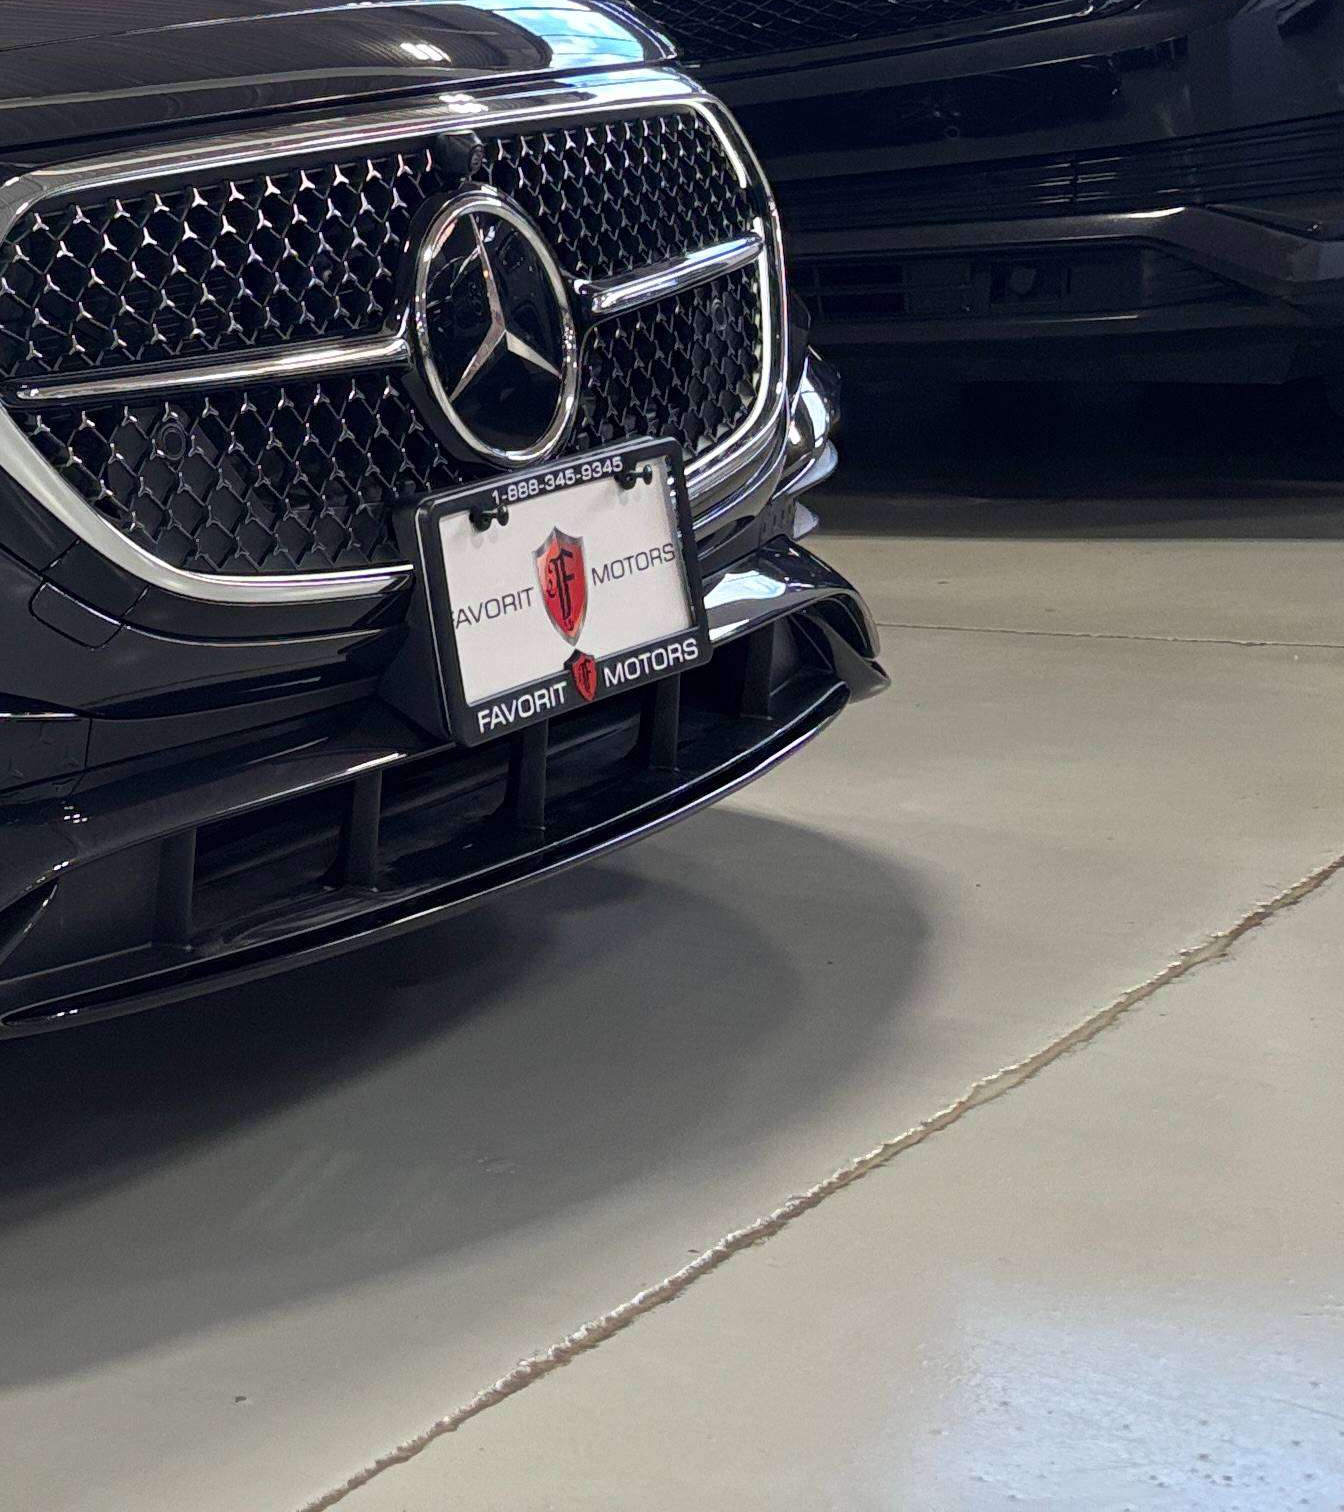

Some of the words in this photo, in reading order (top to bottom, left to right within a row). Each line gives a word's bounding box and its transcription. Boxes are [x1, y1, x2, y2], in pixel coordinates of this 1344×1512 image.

[491, 455, 624, 506] 1-888-345-9345
[451, 586, 535, 631] AVORIT
[591, 542, 677, 587] MOTORS
[477, 681, 569, 734] FAVORIT
[603, 637, 700, 688] MOTORS
